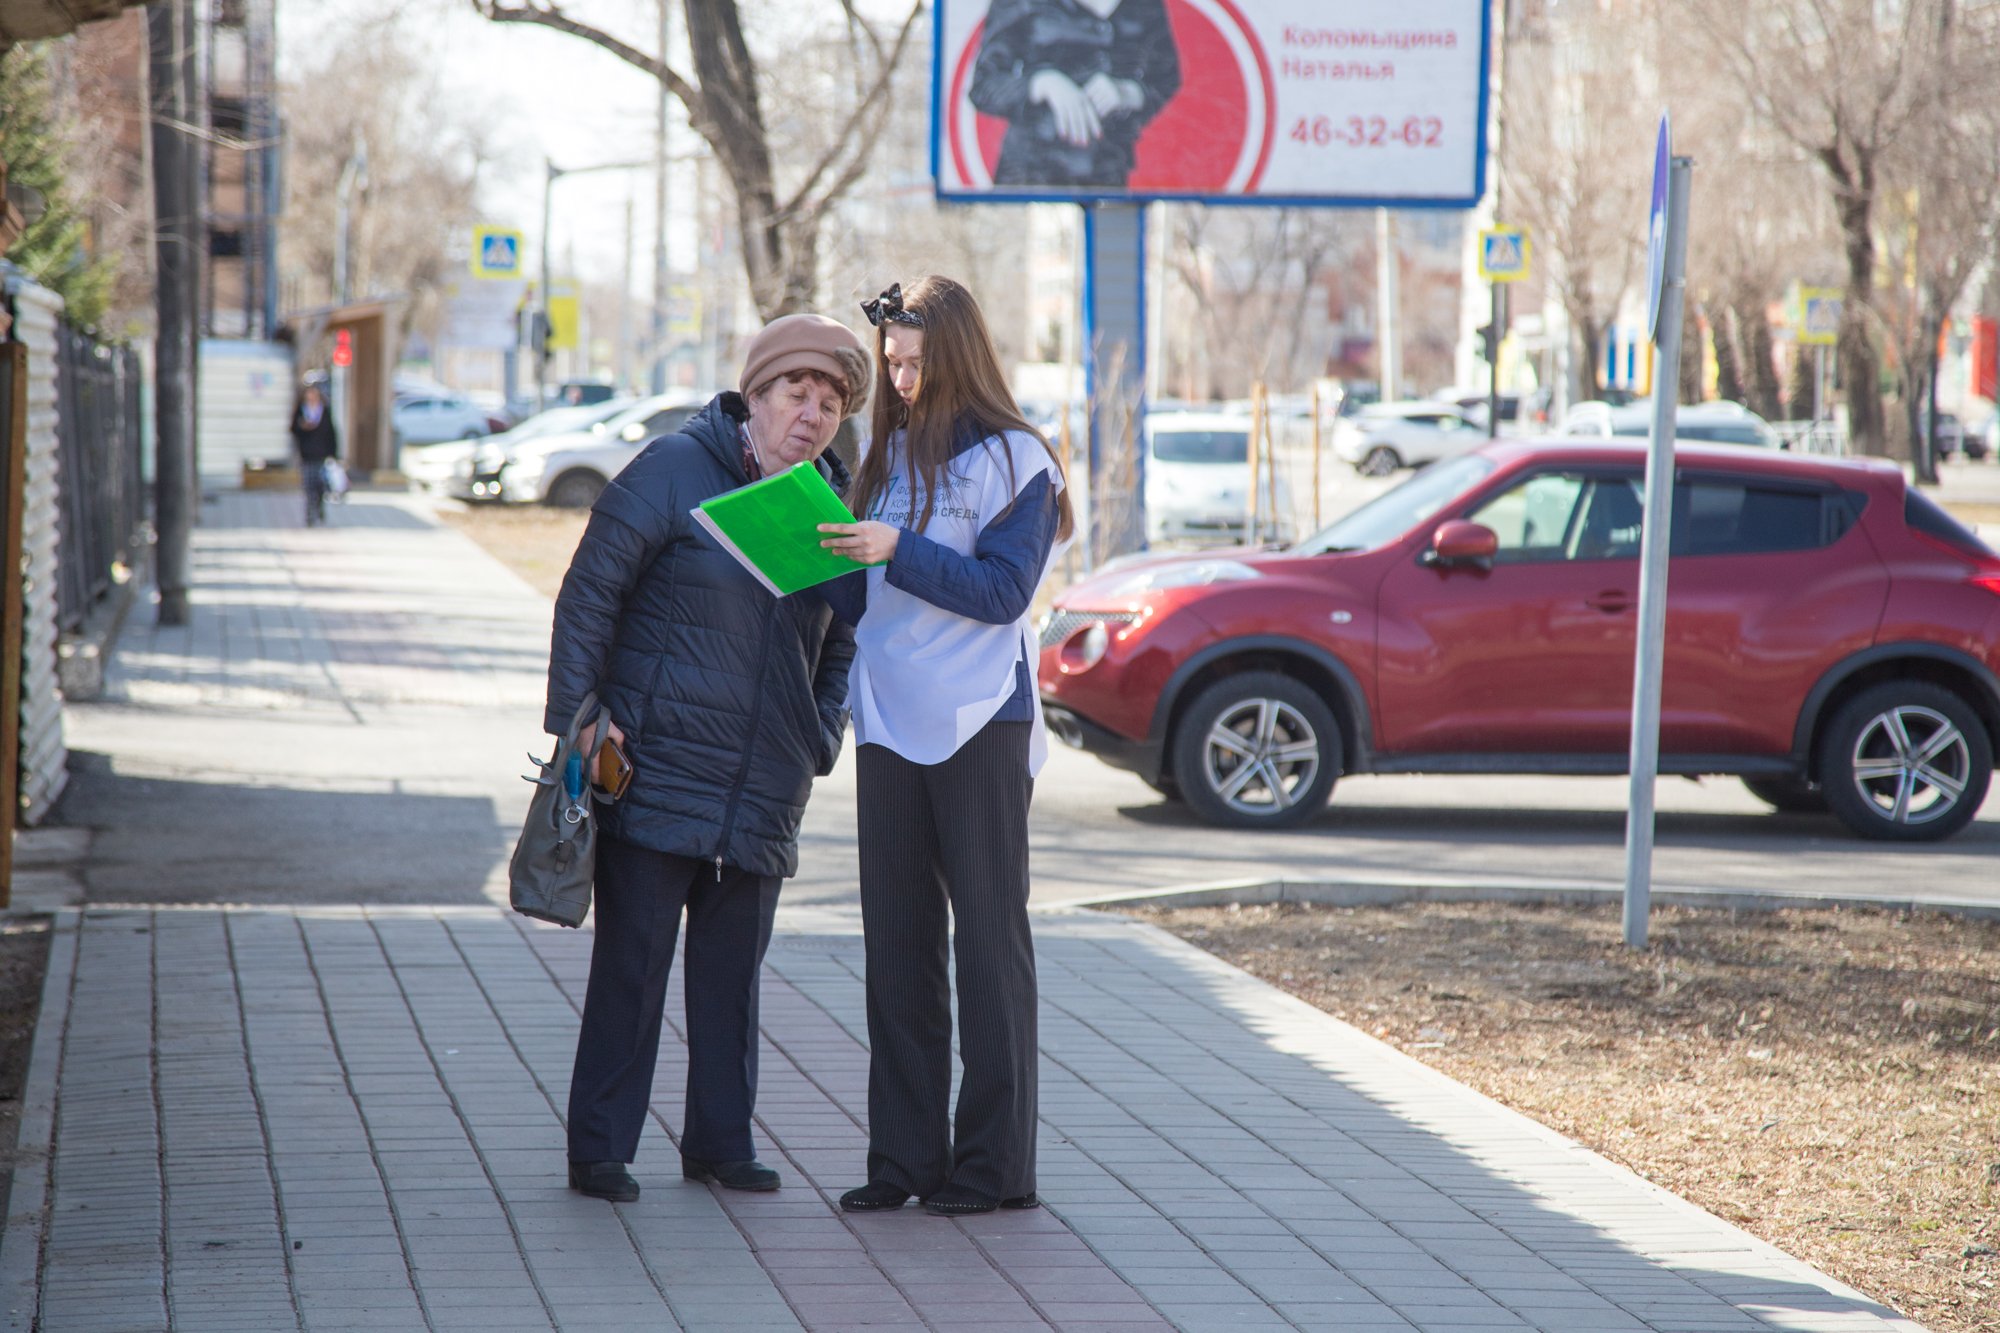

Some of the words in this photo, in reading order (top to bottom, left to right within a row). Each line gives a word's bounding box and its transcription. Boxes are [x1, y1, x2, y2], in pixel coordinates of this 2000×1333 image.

[1282, 57, 1396, 79] Наталья
[1291, 116, 1444, 146] 46-32-62
[887, 505, 937, 522] ГОРОСЙ
[940, 507, 979, 520] СРЕДЫ
